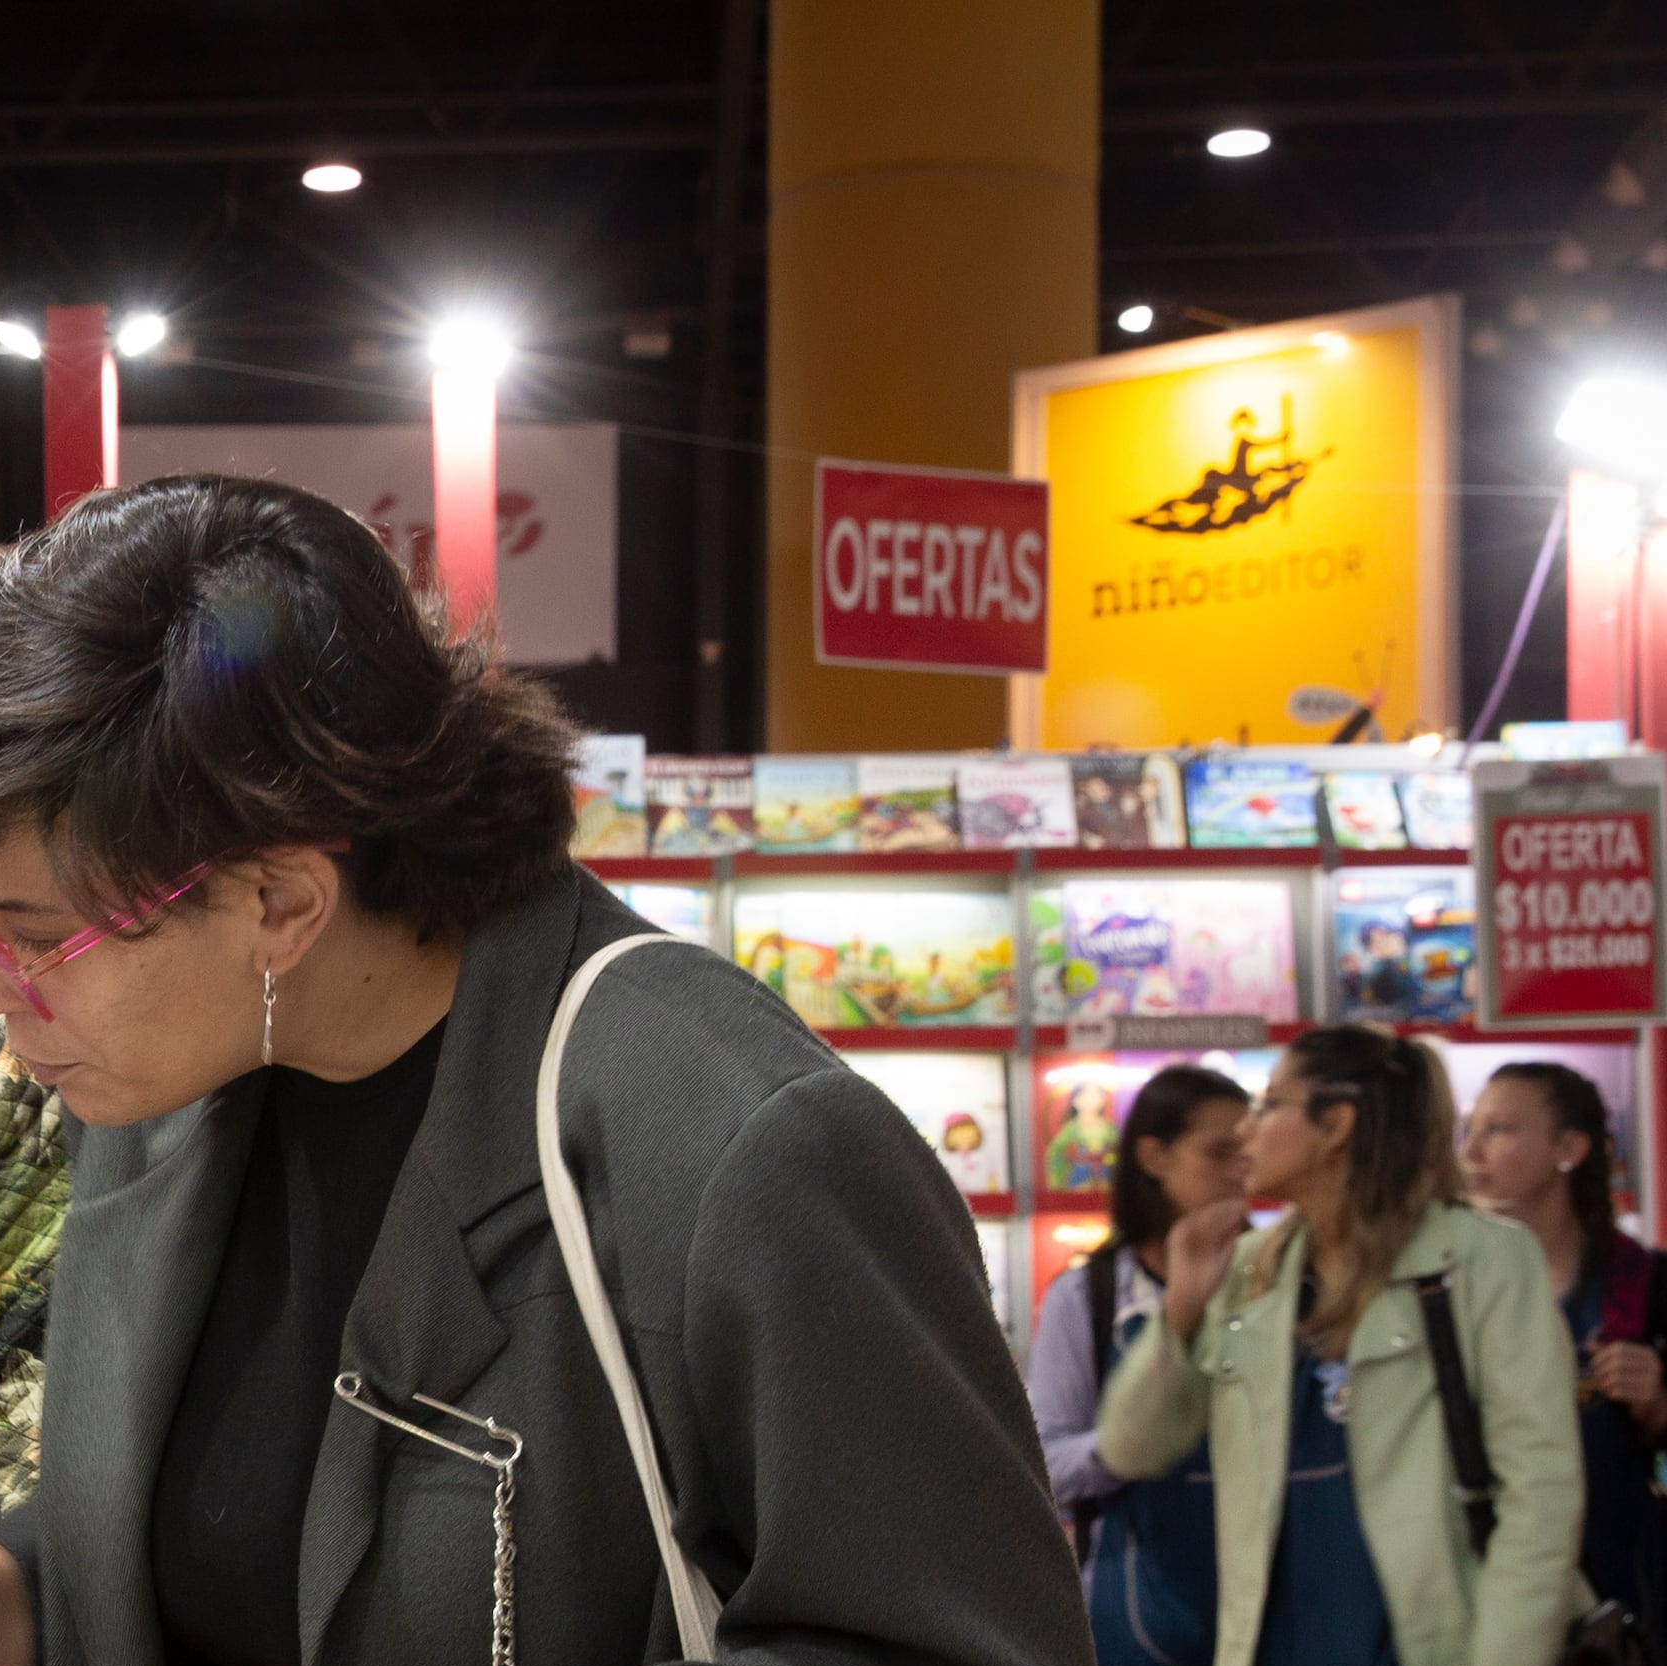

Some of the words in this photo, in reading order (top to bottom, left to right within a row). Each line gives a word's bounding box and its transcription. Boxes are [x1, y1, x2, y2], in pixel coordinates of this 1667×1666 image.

[825, 516, 1042, 623] OFERTAS
[1503, 821, 1643, 872] OFERTA
[1496, 880, 1654, 932] $10.000
